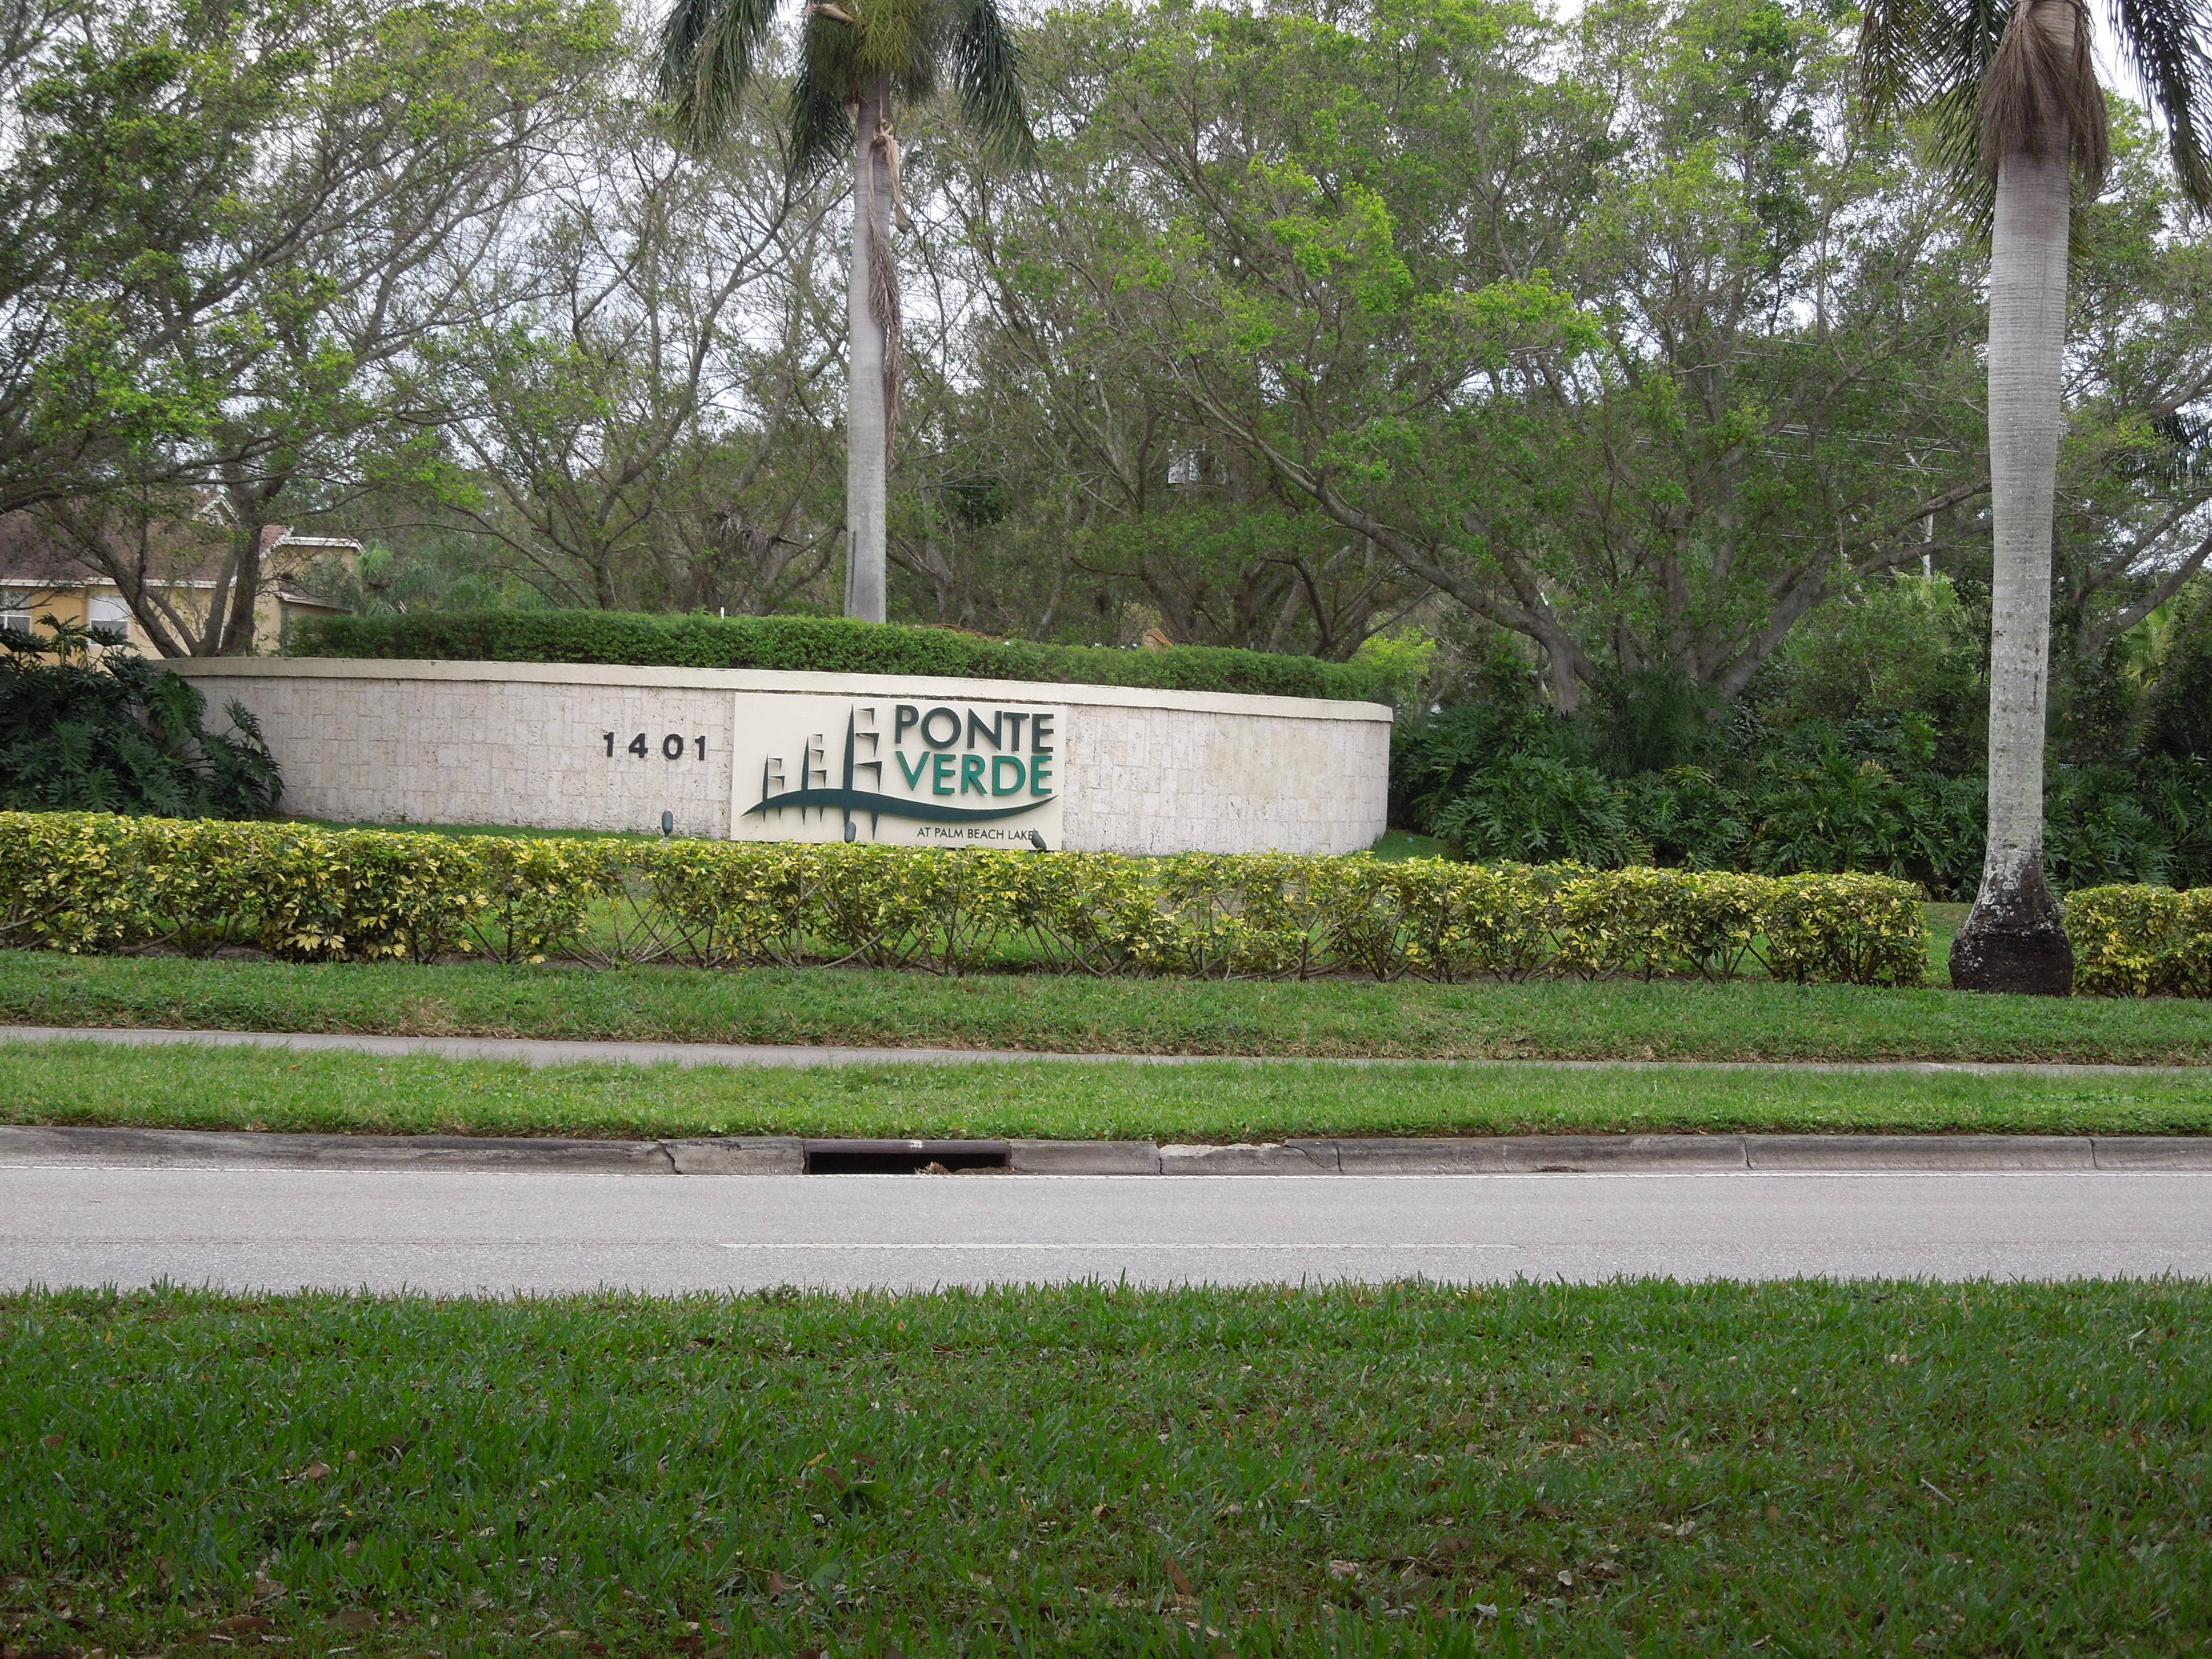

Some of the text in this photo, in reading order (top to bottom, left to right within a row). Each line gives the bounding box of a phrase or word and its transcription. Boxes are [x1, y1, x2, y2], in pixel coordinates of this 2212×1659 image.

[603, 731, 706, 761] 1401
[894, 704, 1054, 753] PONTE
[895, 751, 1053, 796] VERDE
[917, 827, 1038, 841] AT PALM BEACH LAKE
